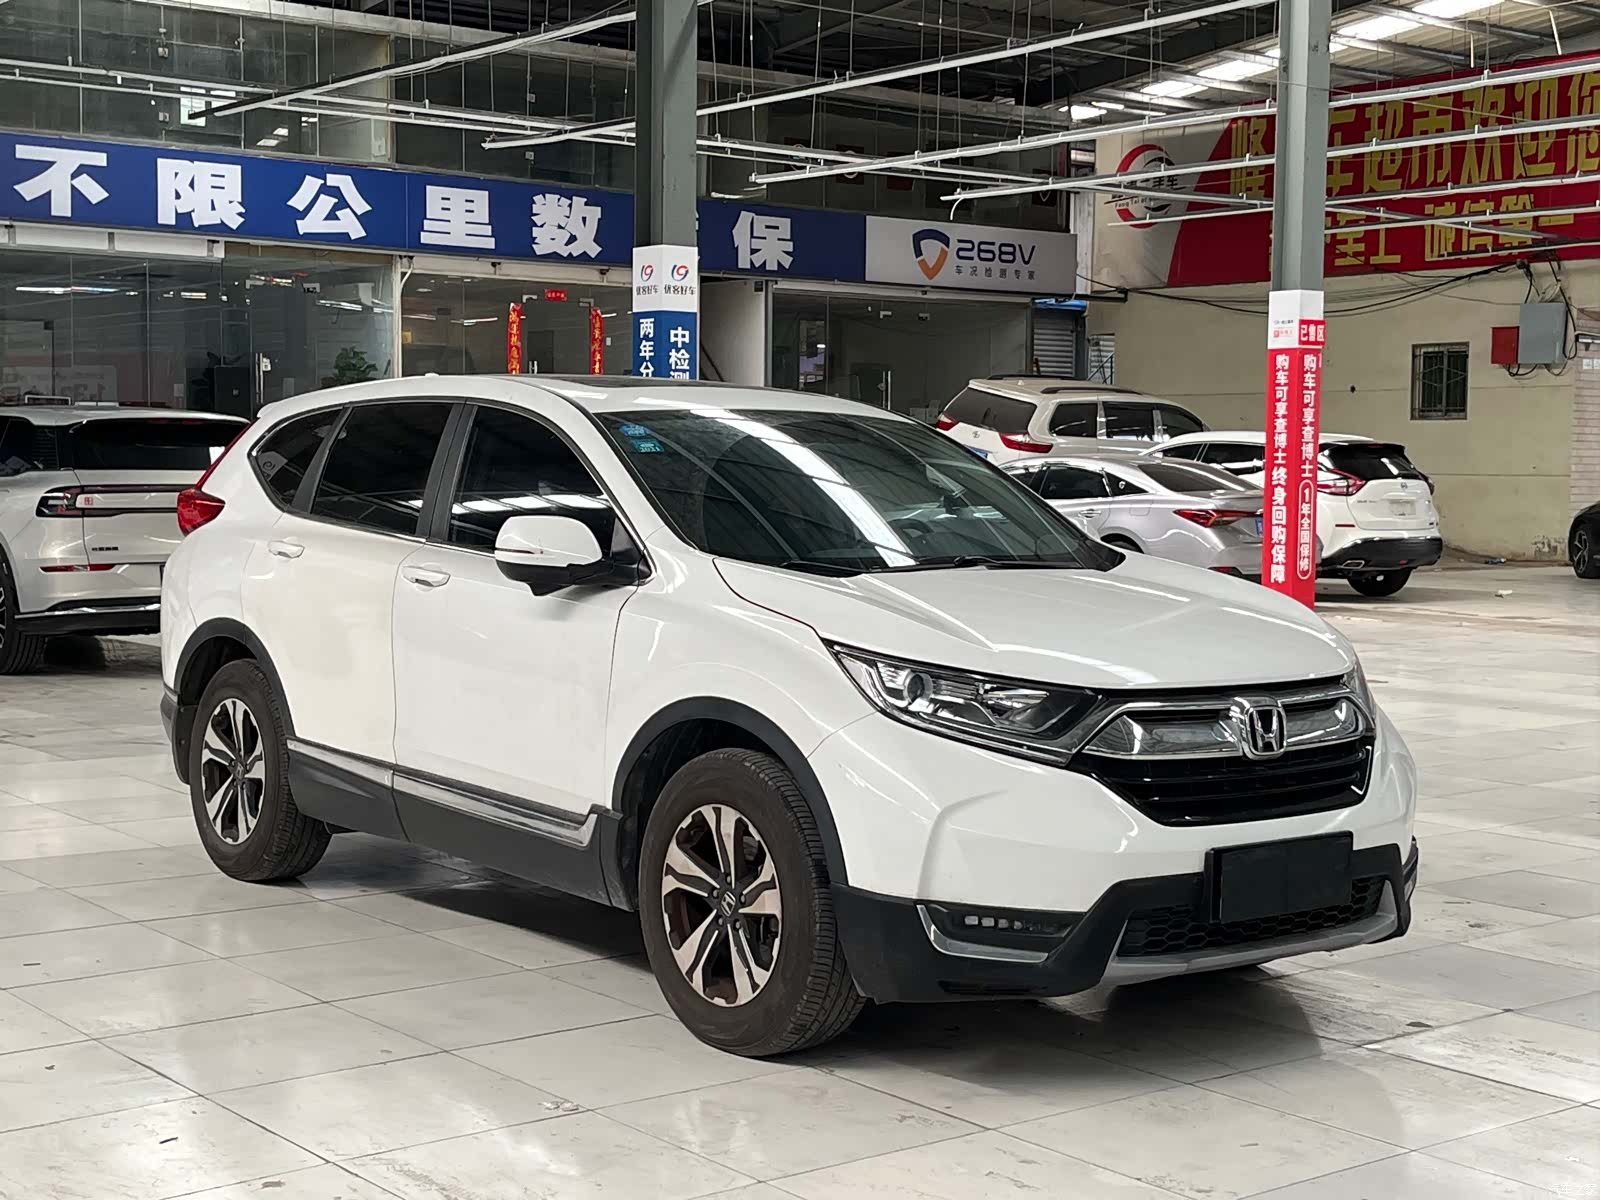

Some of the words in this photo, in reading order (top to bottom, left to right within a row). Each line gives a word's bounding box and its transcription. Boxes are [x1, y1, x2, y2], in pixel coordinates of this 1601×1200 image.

[1230, 72, 1600, 199] 峰车超市欢迎您
[13, 143, 796, 272] 不限公里数保
[955, 238, 1037, 266] 268V
[954, 264, 1036, 281] 车况检测专家
[1270, 353, 1290, 584] 购车可享查博士终身回购保障
[1300, 353, 1317, 478] 购车可享查博士
